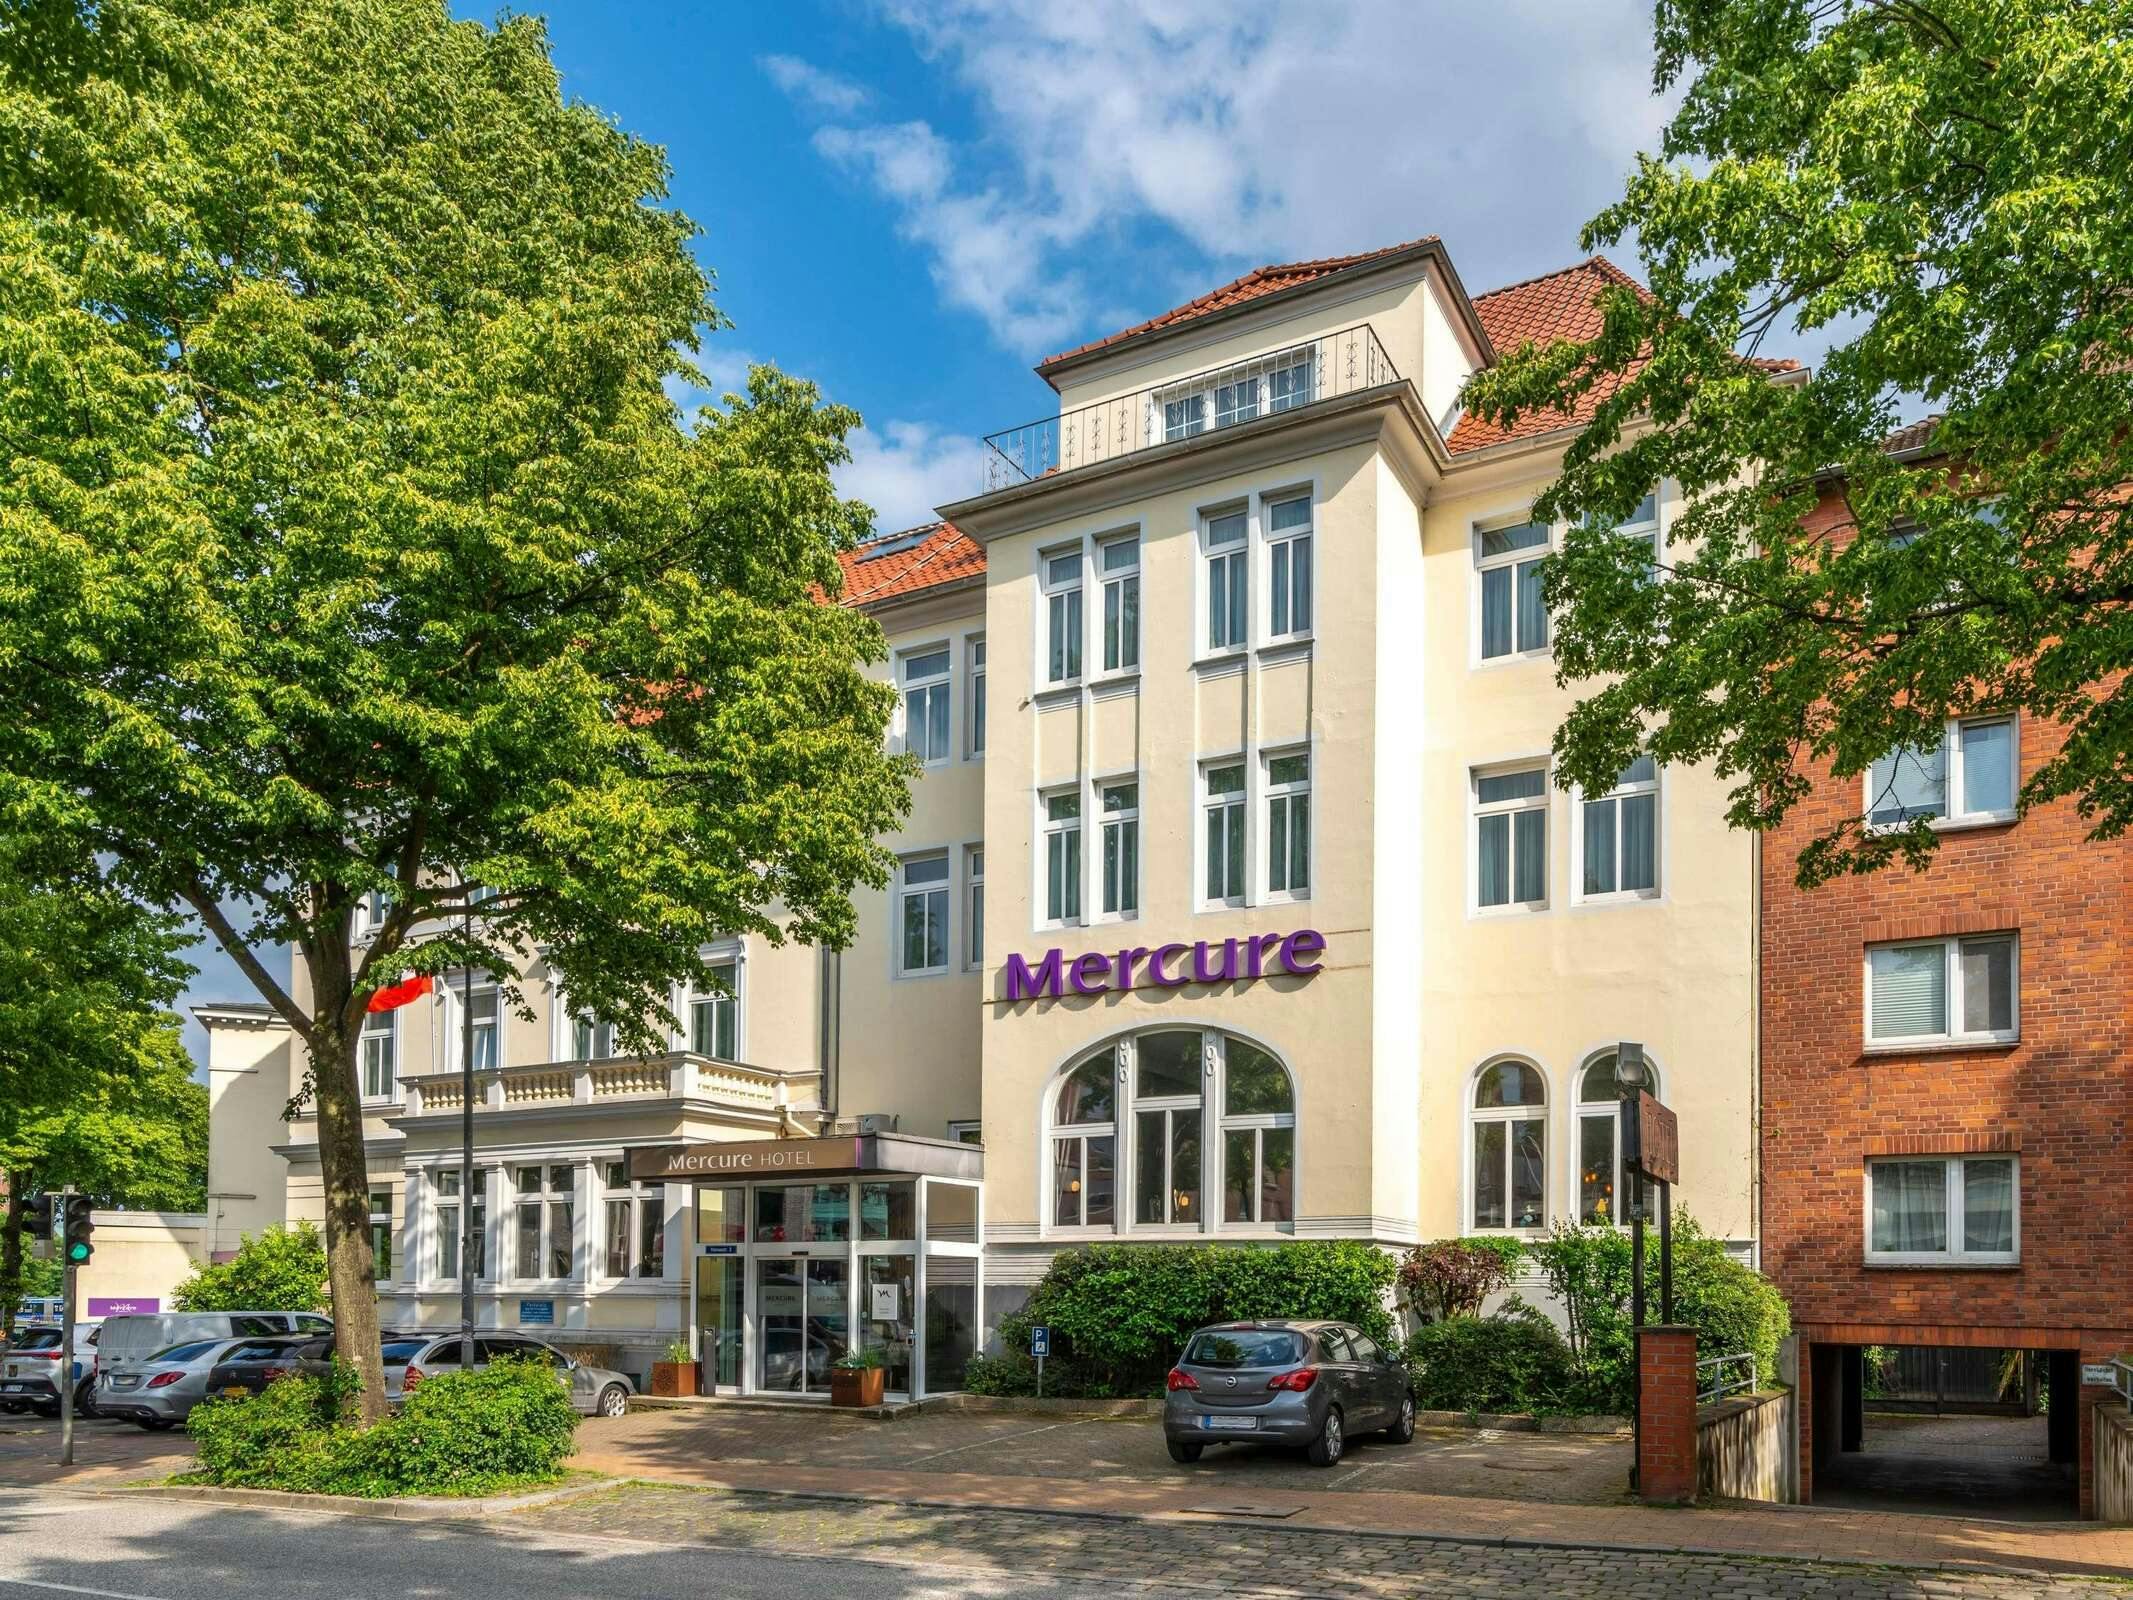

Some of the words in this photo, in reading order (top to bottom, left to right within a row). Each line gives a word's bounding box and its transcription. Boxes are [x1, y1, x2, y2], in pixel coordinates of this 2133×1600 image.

[1007, 929, 1327, 1001] Mercure
[668, 1152, 753, 1171] Mercure
[760, 1151, 815, 1166] HOTEL
[1035, 1329, 1043, 1341] P
